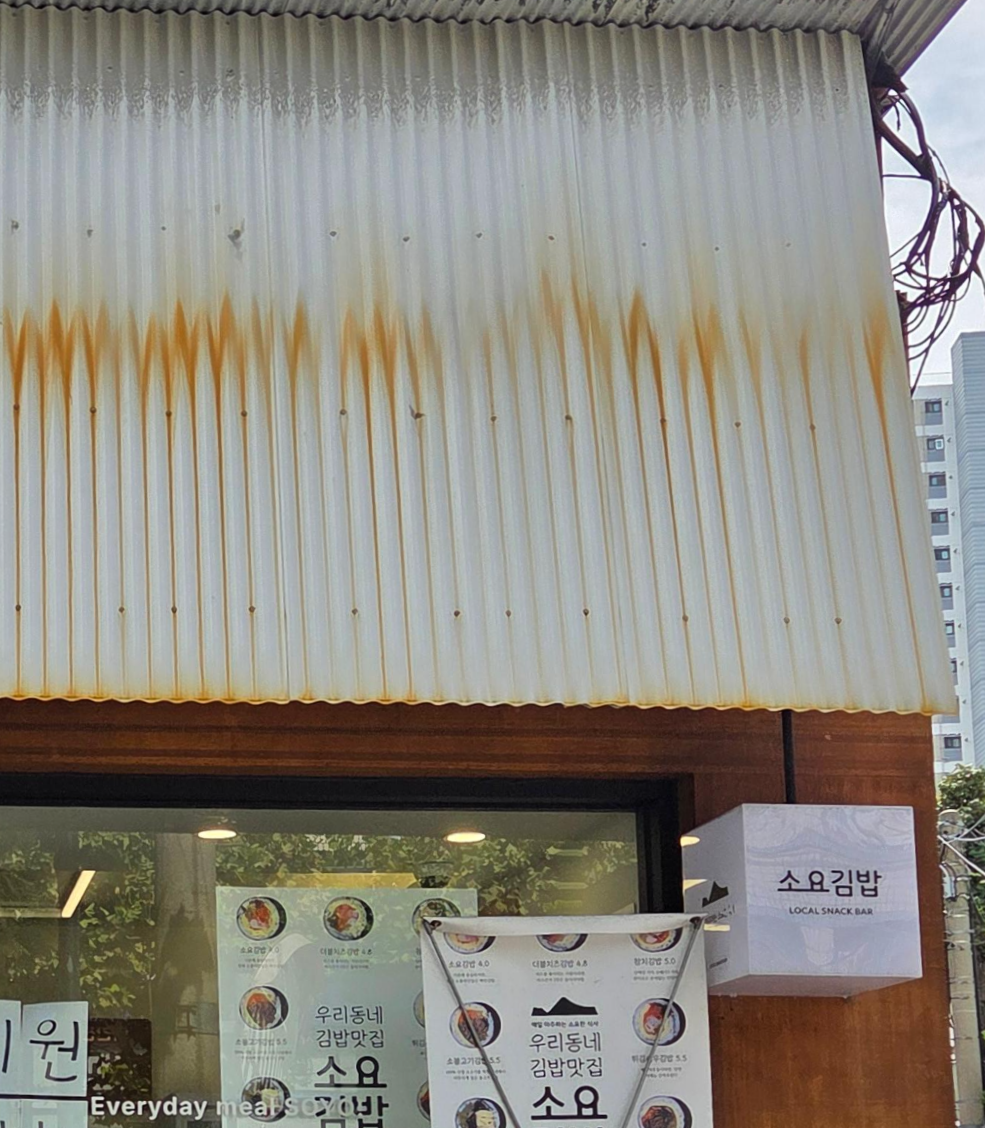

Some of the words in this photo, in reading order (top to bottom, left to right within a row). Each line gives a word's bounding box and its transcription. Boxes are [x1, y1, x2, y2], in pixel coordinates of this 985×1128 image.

[777, 869, 882, 897] 소요김밥
[789, 906, 820, 915] LOCAL
[821, 906, 853, 916] SNACK
[855, 907, 873, 916] BAR
[448, 960, 476, 969] 소요김밥
[478, 959, 491, 968] 4.0
[633, 957, 663, 967] 참치김밥
[664, 956, 676, 966] 5.0
[315, 1005, 384, 1025] 우리동네
[315, 1029, 385, 1049] 김밥맛집
[529, 1032, 602, 1053] 우리동네
[530, 1057, 603, 1079] 김밥맛집
[631, 1054, 674, 1064] 튀김우김밥
[675, 1054, 688, 1063] 5.5
[314, 1055, 388, 1088] 소요
[90, 1096, 205, 1121] Everyday
[217, 1096, 276, 1116] meal
[531, 1085, 608, 1120] 소요
